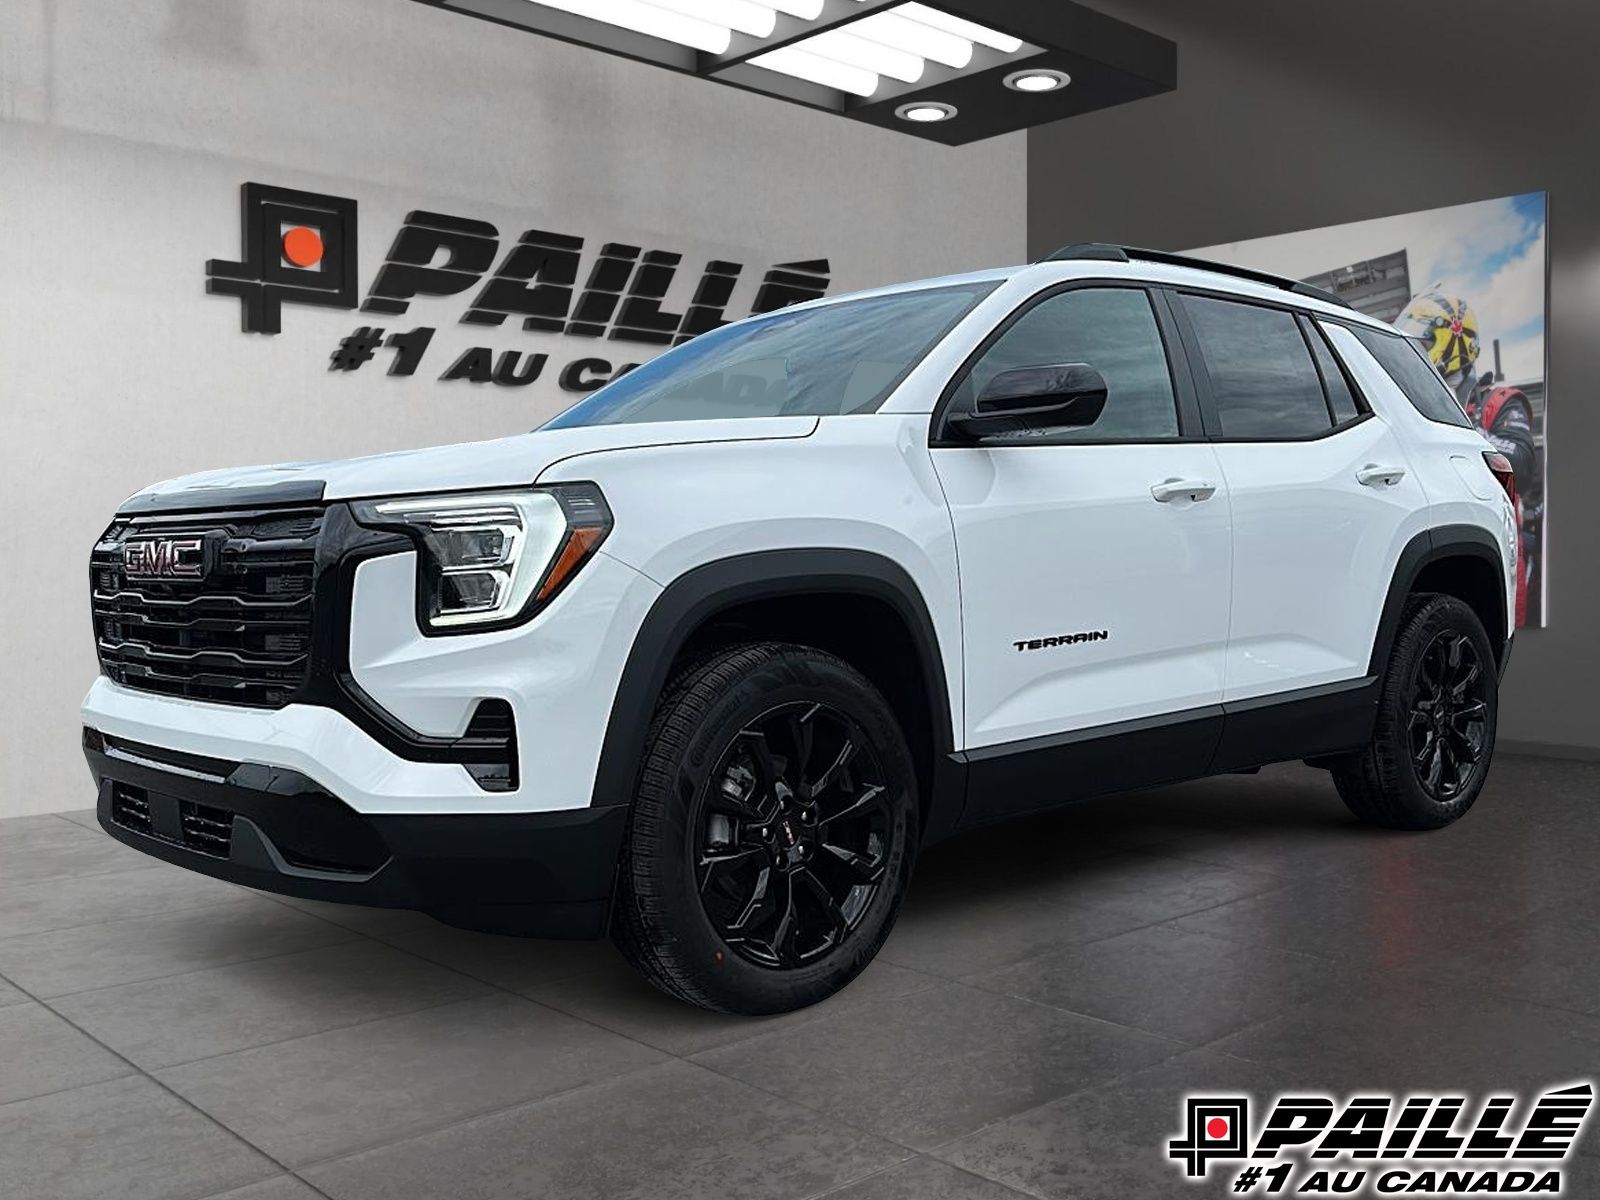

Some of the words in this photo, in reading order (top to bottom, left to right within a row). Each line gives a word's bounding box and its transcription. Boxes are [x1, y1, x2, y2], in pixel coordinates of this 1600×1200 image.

[327, 326, 435, 377] #1
[438, 347, 549, 387] AU
[124, 539, 202, 577] GMC
[1012, 630, 1109, 652] TERRAIN
